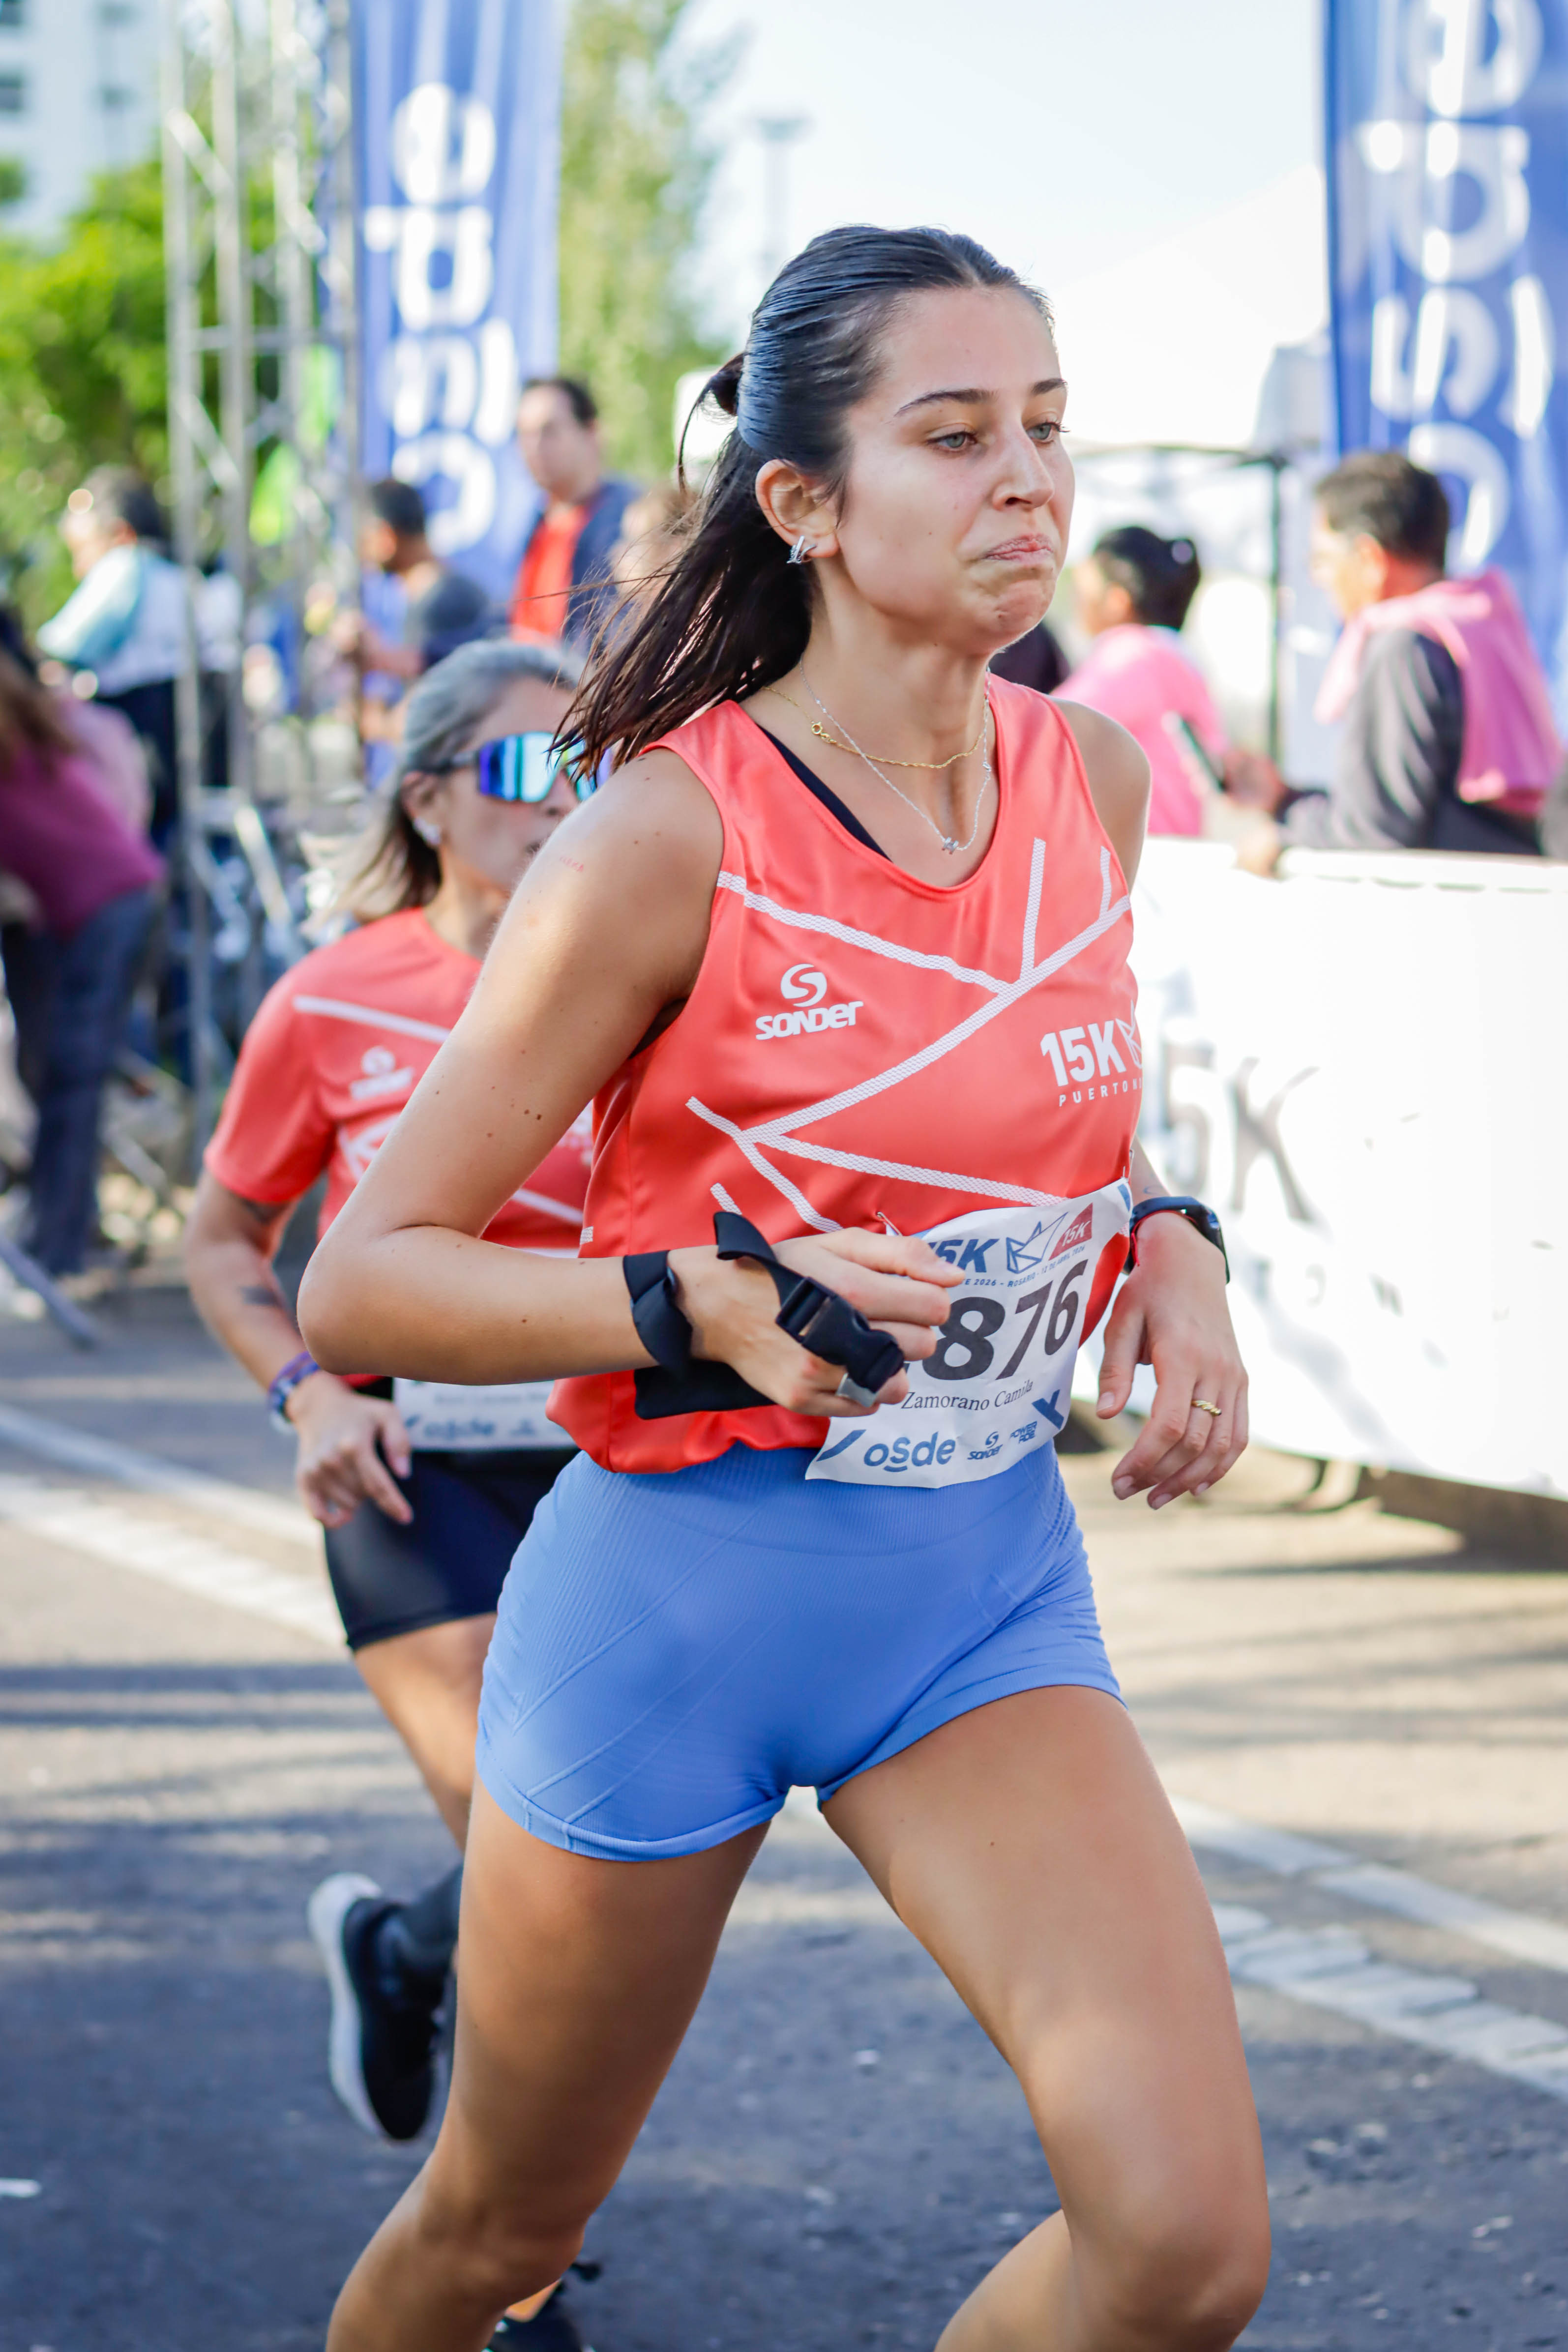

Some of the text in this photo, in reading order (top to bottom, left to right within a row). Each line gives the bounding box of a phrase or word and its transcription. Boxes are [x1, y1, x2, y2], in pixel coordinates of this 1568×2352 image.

[1040, 1020, 1126, 1087] 15K
[1059, 1080, 1128, 1107] PUERTO
[1062, 1220, 1091, 1247] 15K
[928, 1238, 1000, 1273] 5K
[904, 1259, 1088, 1381] 876
[901, 1379, 1034, 1411] Zamorano Camila
[863, 1431, 956, 1472] osde
